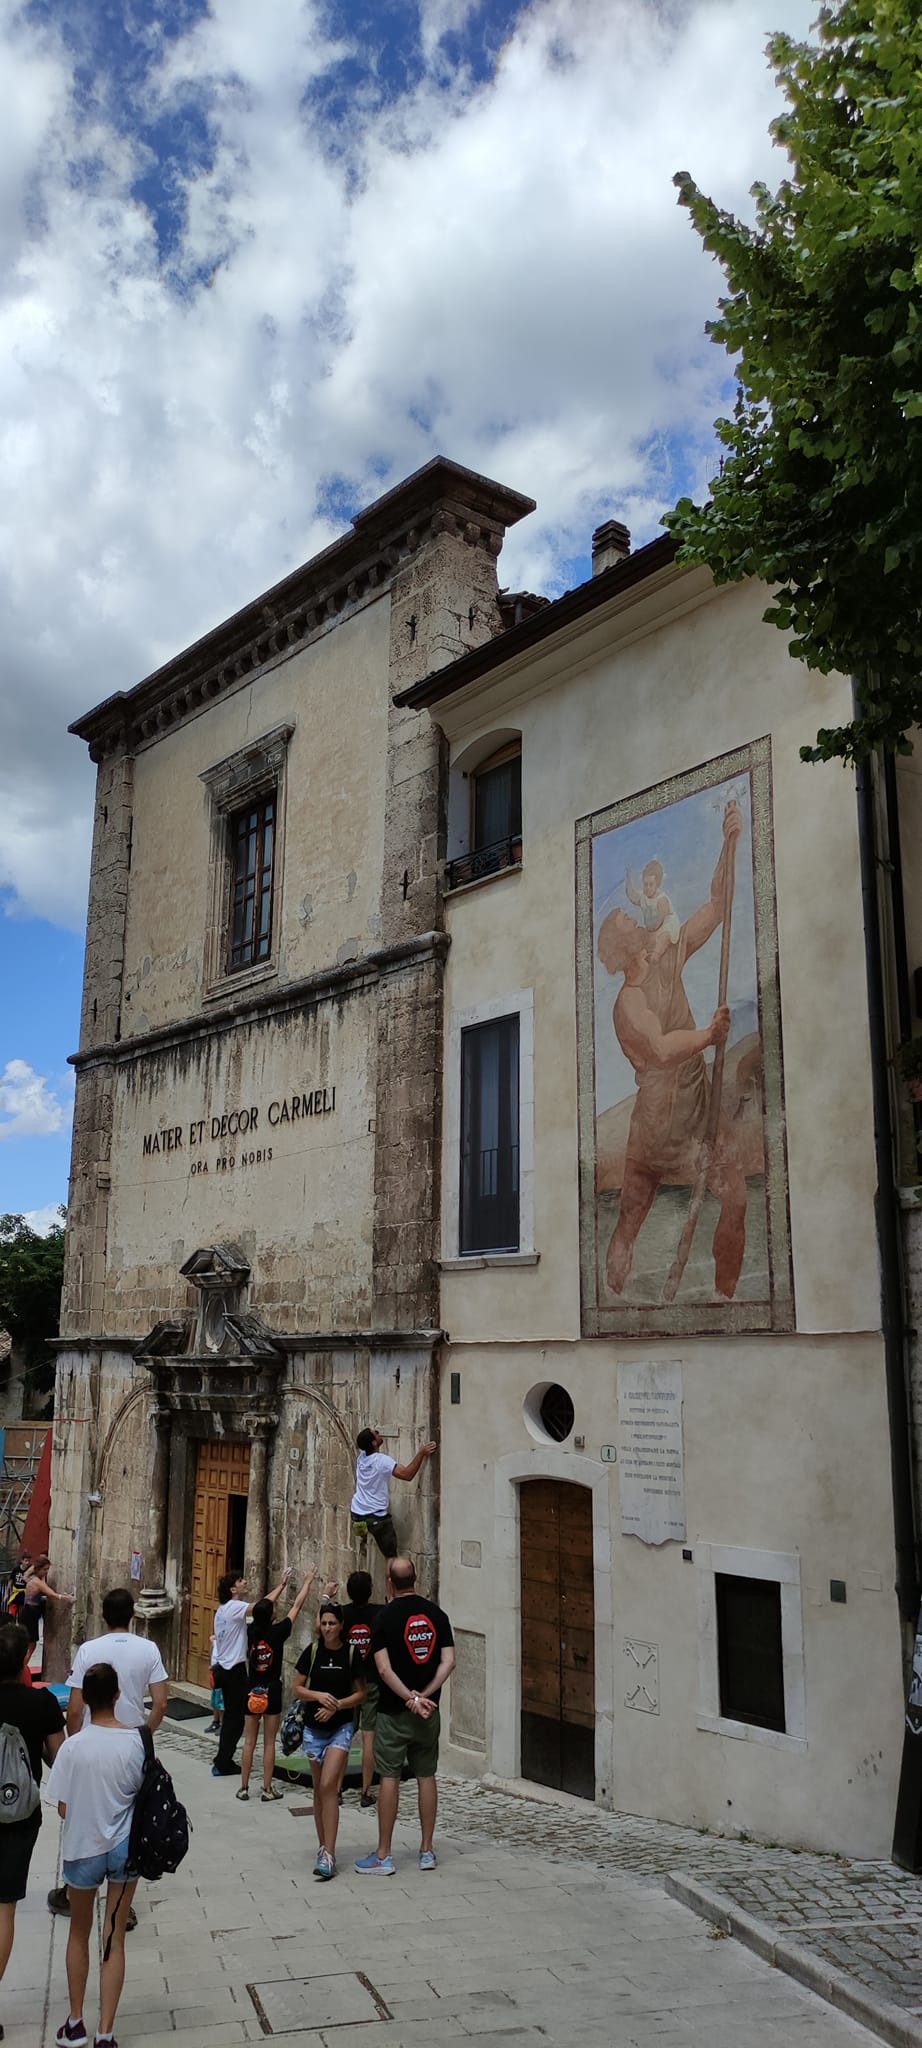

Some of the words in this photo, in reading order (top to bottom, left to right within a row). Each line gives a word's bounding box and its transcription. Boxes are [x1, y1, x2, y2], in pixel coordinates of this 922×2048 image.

[142, 1126, 182, 1157] MATER
[189, 1120, 206, 1145] ET
[211, 1107, 259, 1140] DECOR
[268, 1086, 337, 1127] CARMELI
[190, 1162, 209, 1176] ORA
[216, 1156, 236, 1171] PRO
[241, 1147, 273, 1167] NOBIS
[408, 1631, 433, 1642] COAST
